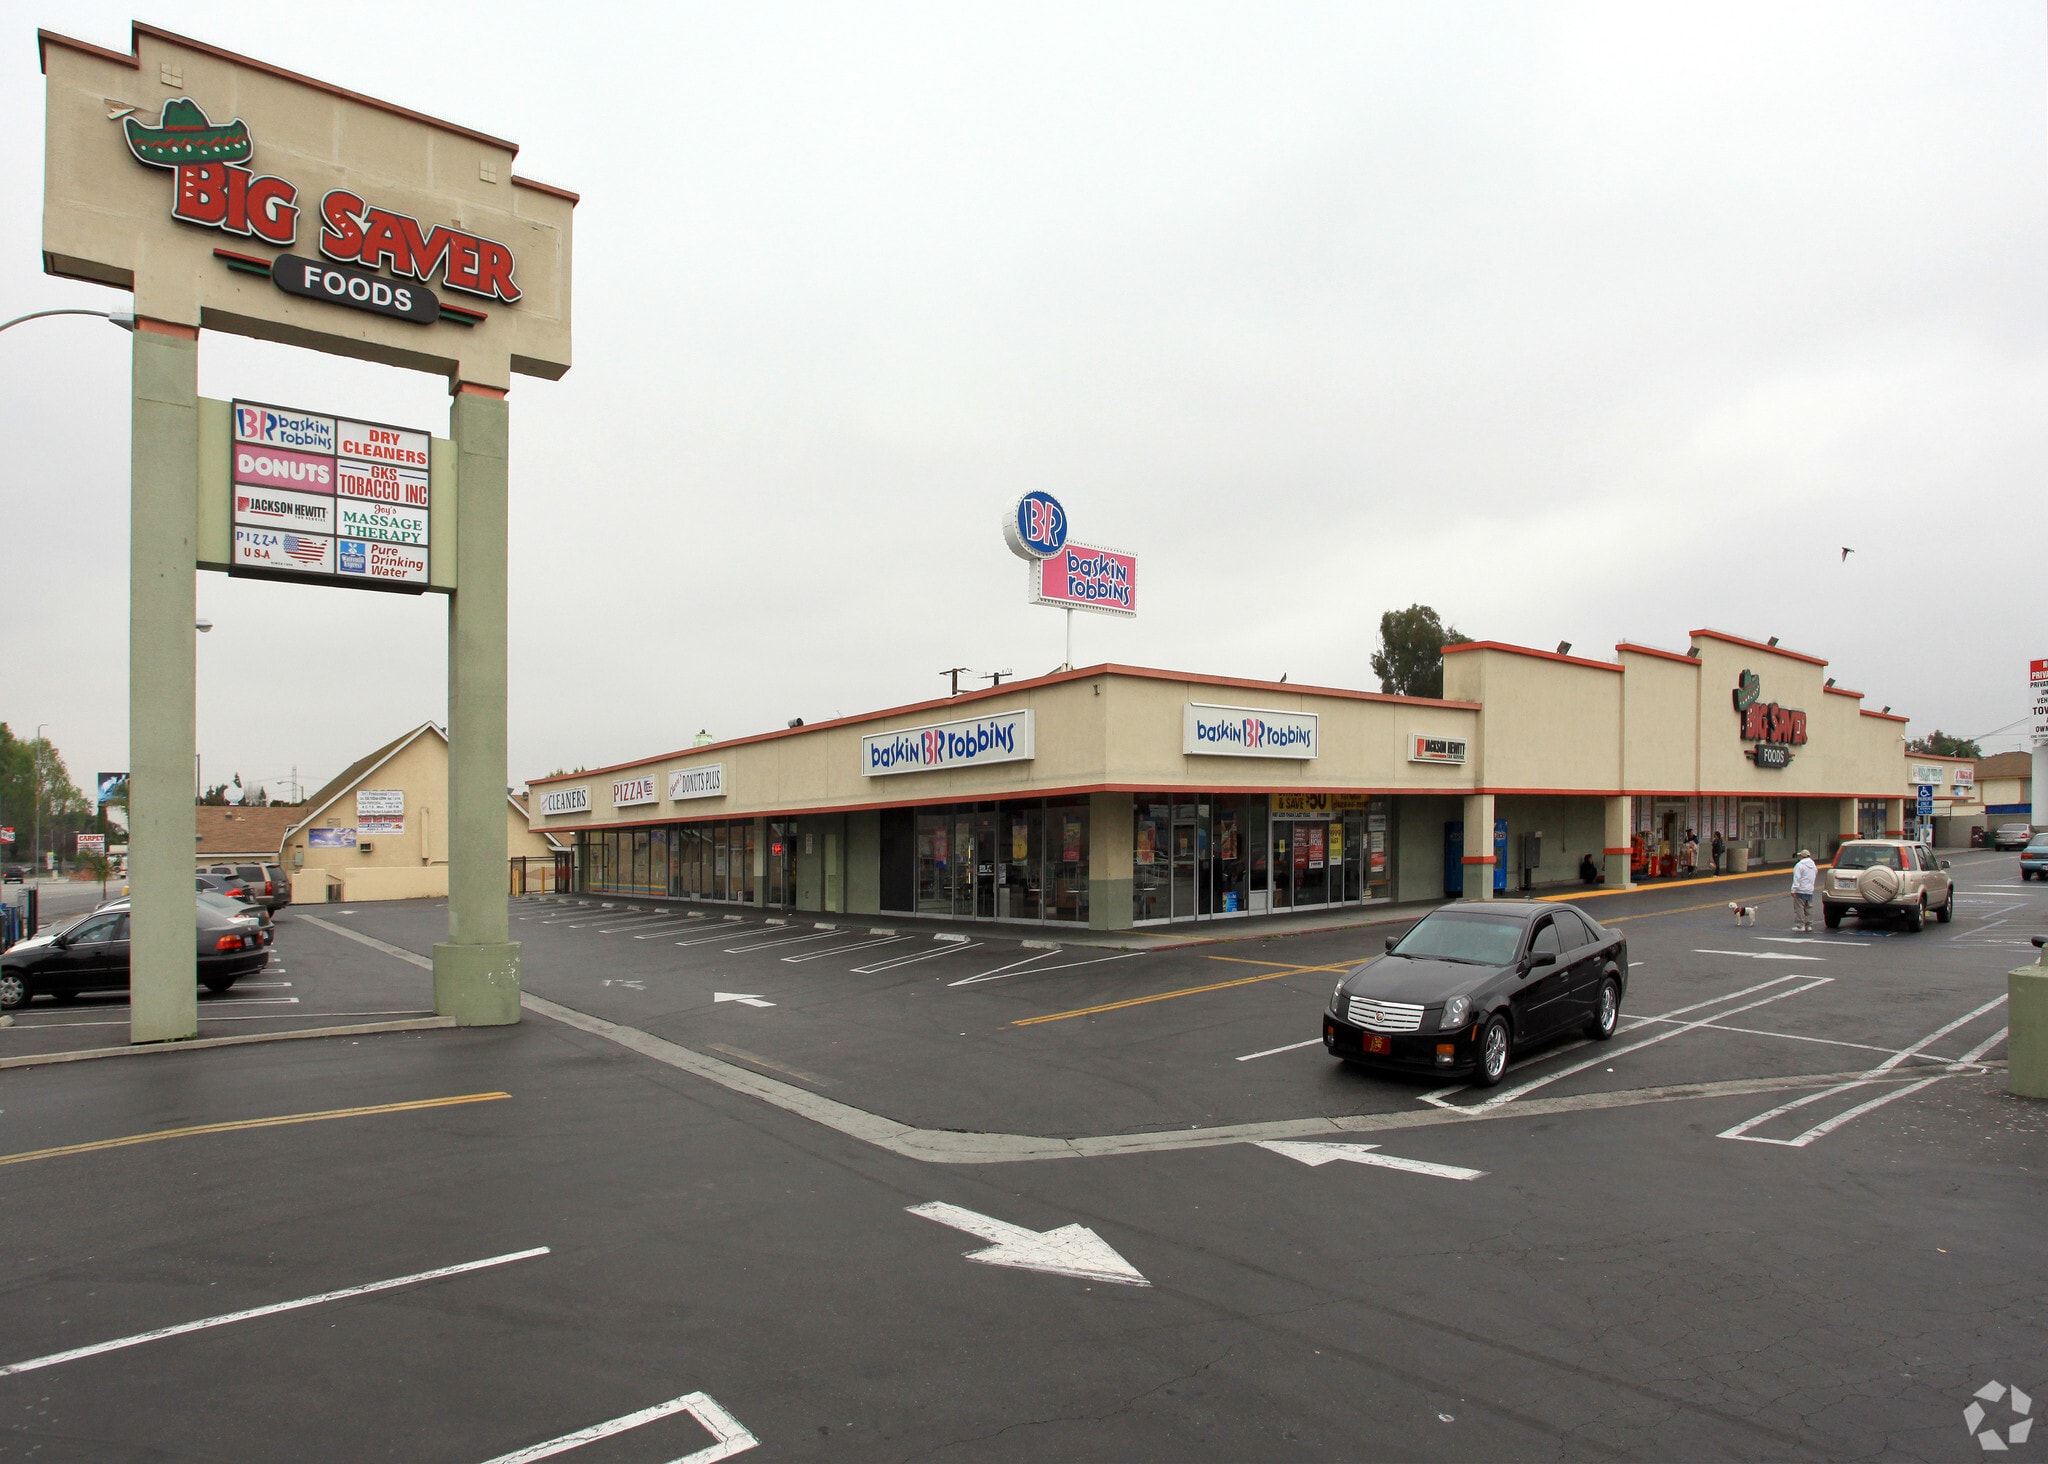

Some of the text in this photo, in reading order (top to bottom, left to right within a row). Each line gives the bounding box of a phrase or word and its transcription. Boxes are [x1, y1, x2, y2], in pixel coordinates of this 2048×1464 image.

[173, 162, 522, 303] BIG SAVER
[303, 265, 413, 312] FOODS
[237, 408, 277, 440] BR
[278, 414, 329, 435] baskin
[280, 430, 332, 450] robbins
[369, 429, 401, 446] DRY
[343, 440, 426, 465] CLEANERS
[238, 453, 330, 484] DONUTS
[371, 465, 397, 481] GKS
[340, 474, 427, 505] TOBACCO INC
[250, 498, 327, 519] JACKSON HEWITT
[374, 504, 397, 515] Joy's
[343, 510, 423, 531] MASSAGE
[1023, 498, 1062, 546] BR
[236, 531, 279, 546] PIZZA
[345, 524, 421, 543] THERAPY
[371, 544, 399, 556] Pure
[371, 555, 424, 572] Drinking
[371, 565, 407, 578] Water
[1065, 549, 1127, 585] baskin
[1067, 575, 1131, 606] robbins
[1197, 718, 1311, 748] baskin BR robbins
[1741, 701, 1808, 745] BIG SAVER
[871, 721, 1014, 768] baskin BR robbins
[1763, 748, 1785, 763] FOODS
[613, 781, 644, 803] PIZZA
[682, 773, 705, 793] DONUTS
[706, 770, 720, 790] PLUS
[548, 789, 586, 811] CLEANERS
[1286, 798, 1304, 809] SAVE
[1872, 879, 1893, 894] HONDA
